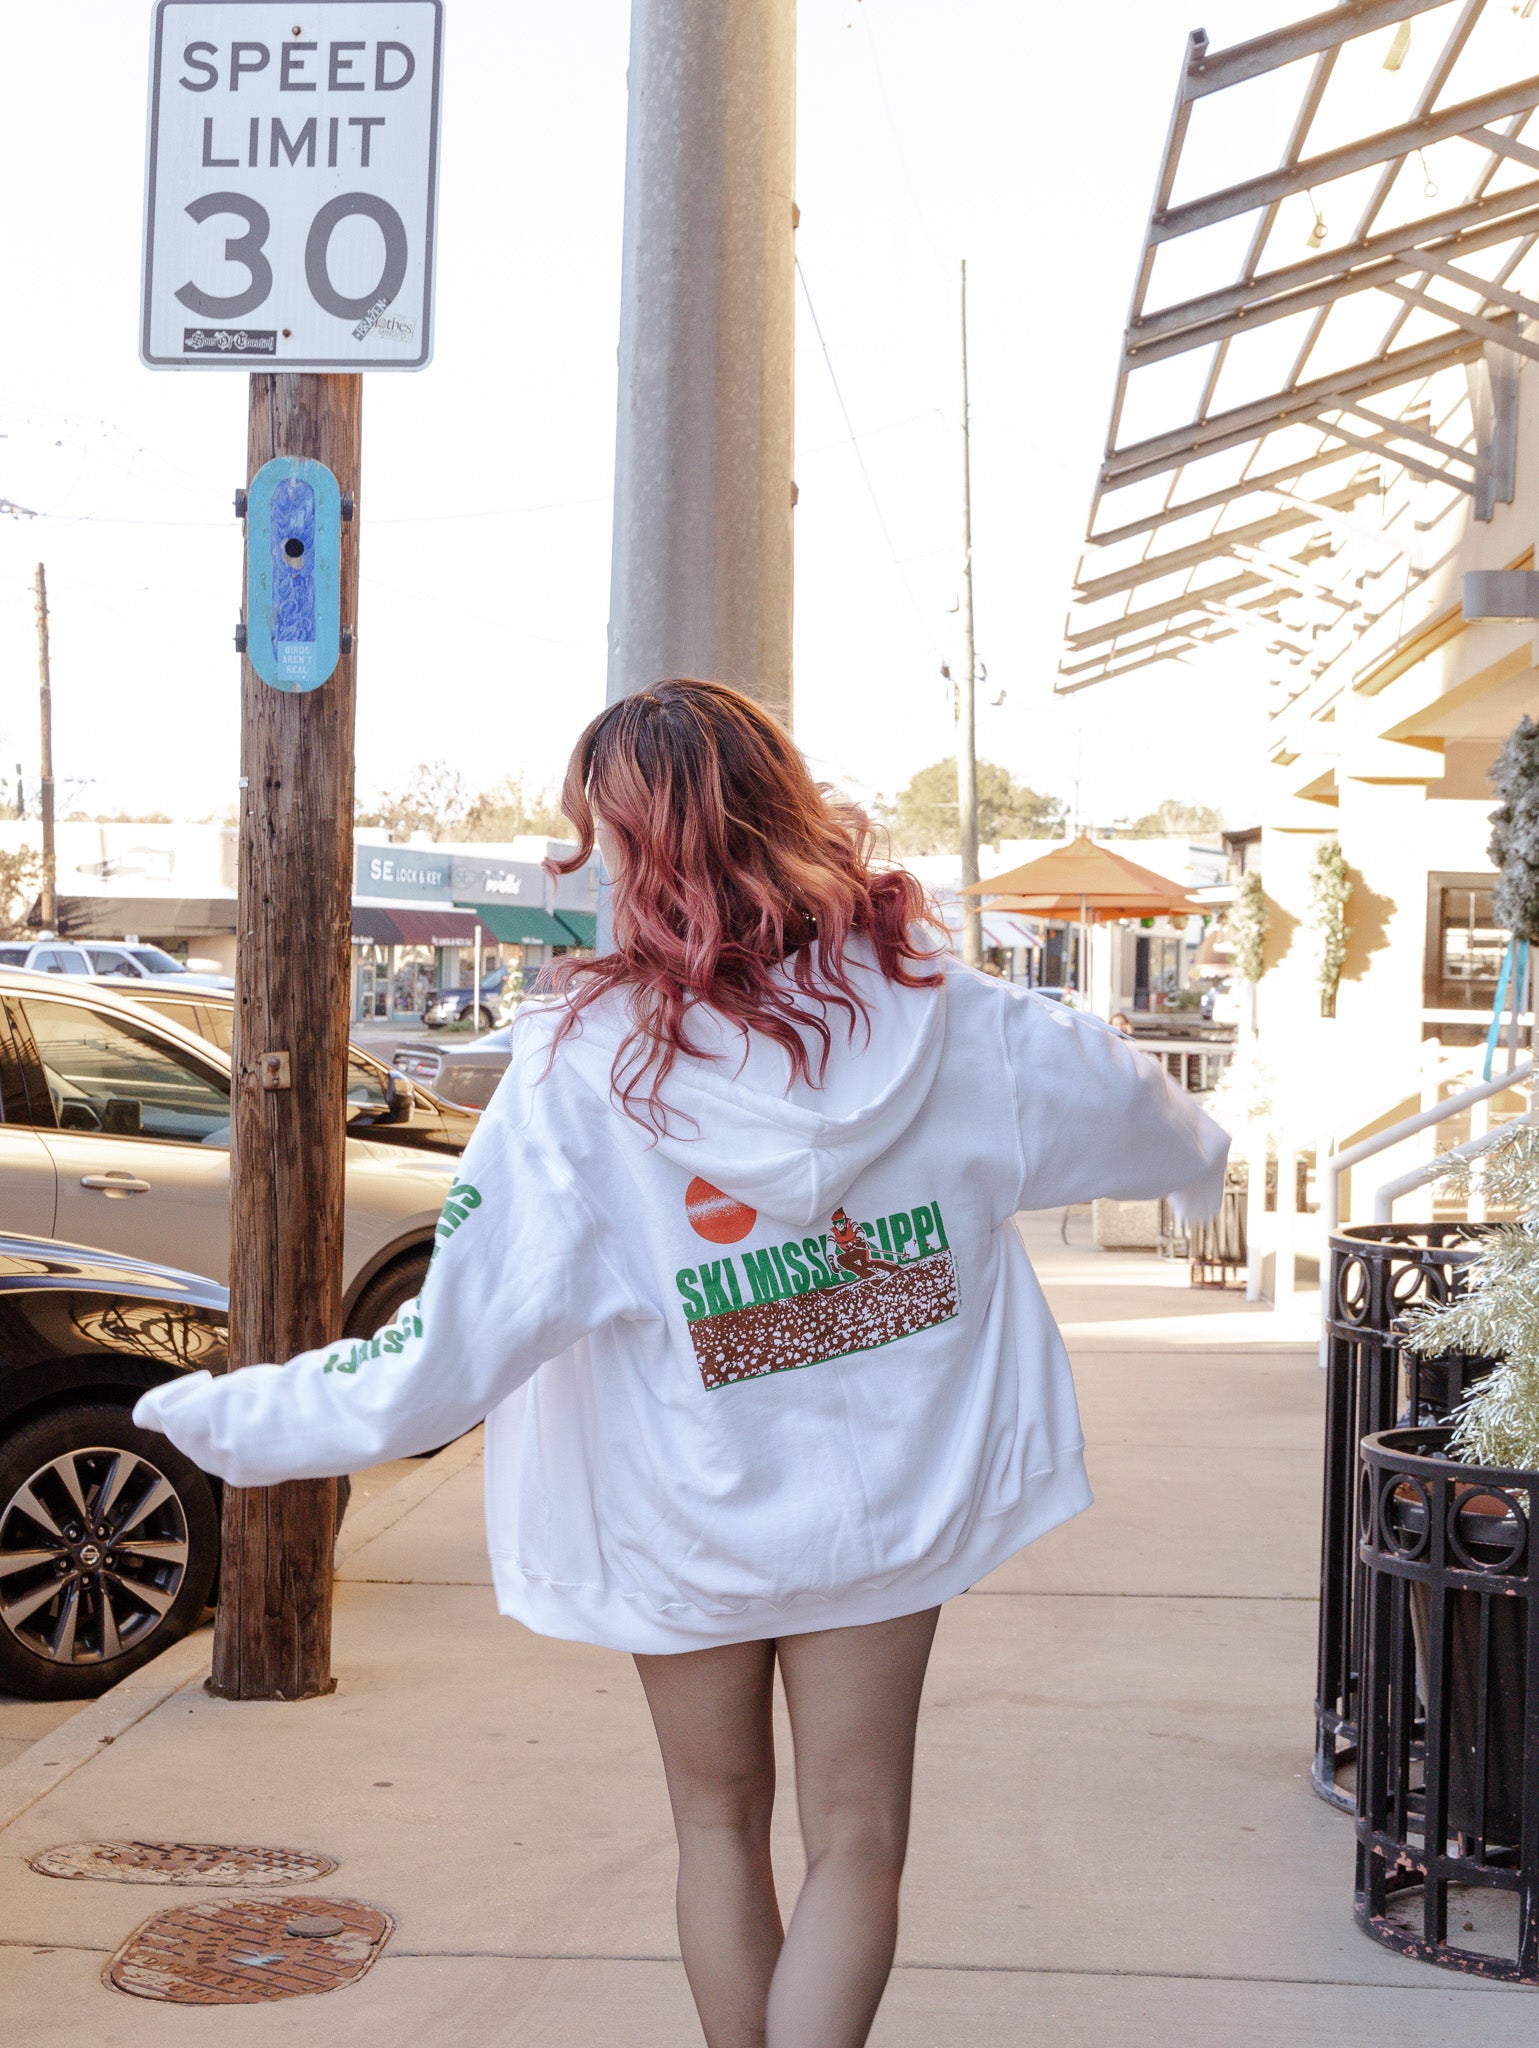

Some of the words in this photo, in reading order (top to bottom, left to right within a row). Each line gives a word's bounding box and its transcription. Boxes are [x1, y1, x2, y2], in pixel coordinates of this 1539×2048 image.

[178, 41, 416, 92] SPEED
[202, 117, 386, 168] LIMIT
[174, 191, 409, 321] 30
[285, 645, 310, 655] BIRDS
[286, 665, 308, 674] REAL
[370, 859, 394, 881] SE
[396, 867, 418, 883] LOCK
[426, 871, 442, 885] KEY
[675, 1257, 745, 1322] SKI
